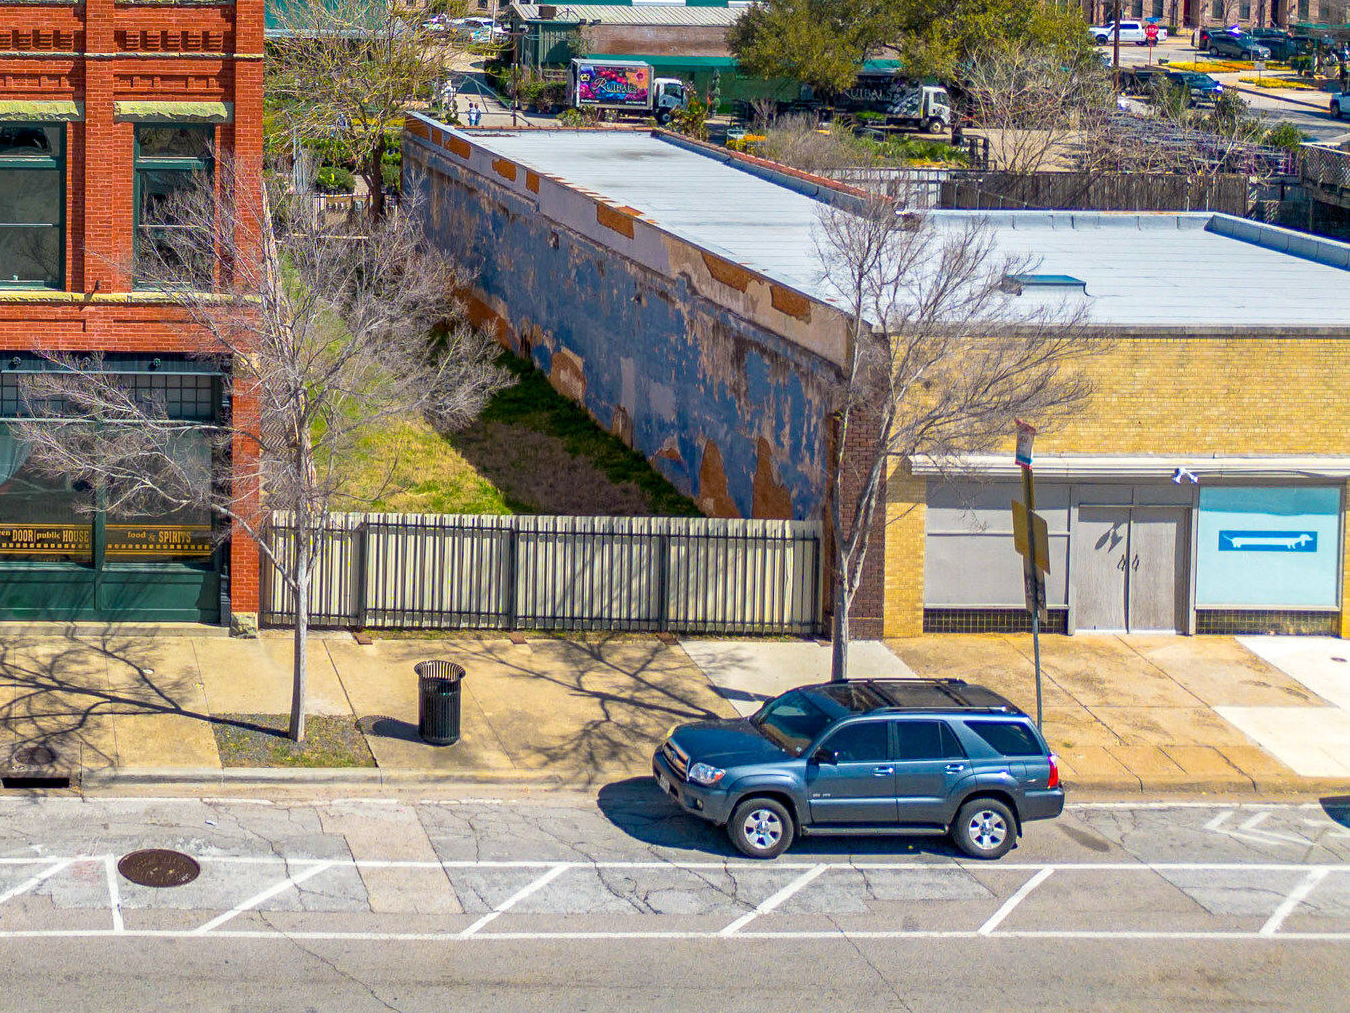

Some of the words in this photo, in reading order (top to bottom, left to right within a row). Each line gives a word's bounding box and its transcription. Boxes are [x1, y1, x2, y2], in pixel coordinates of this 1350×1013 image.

[12, 529, 33, 542] DOOR
[36, 530, 61, 539] public
[63, 530, 89, 542] HOUSE
[127, 531, 147, 539] food
[148, 533, 156, 542] &
[158, 530, 192, 543] SPIRITS
